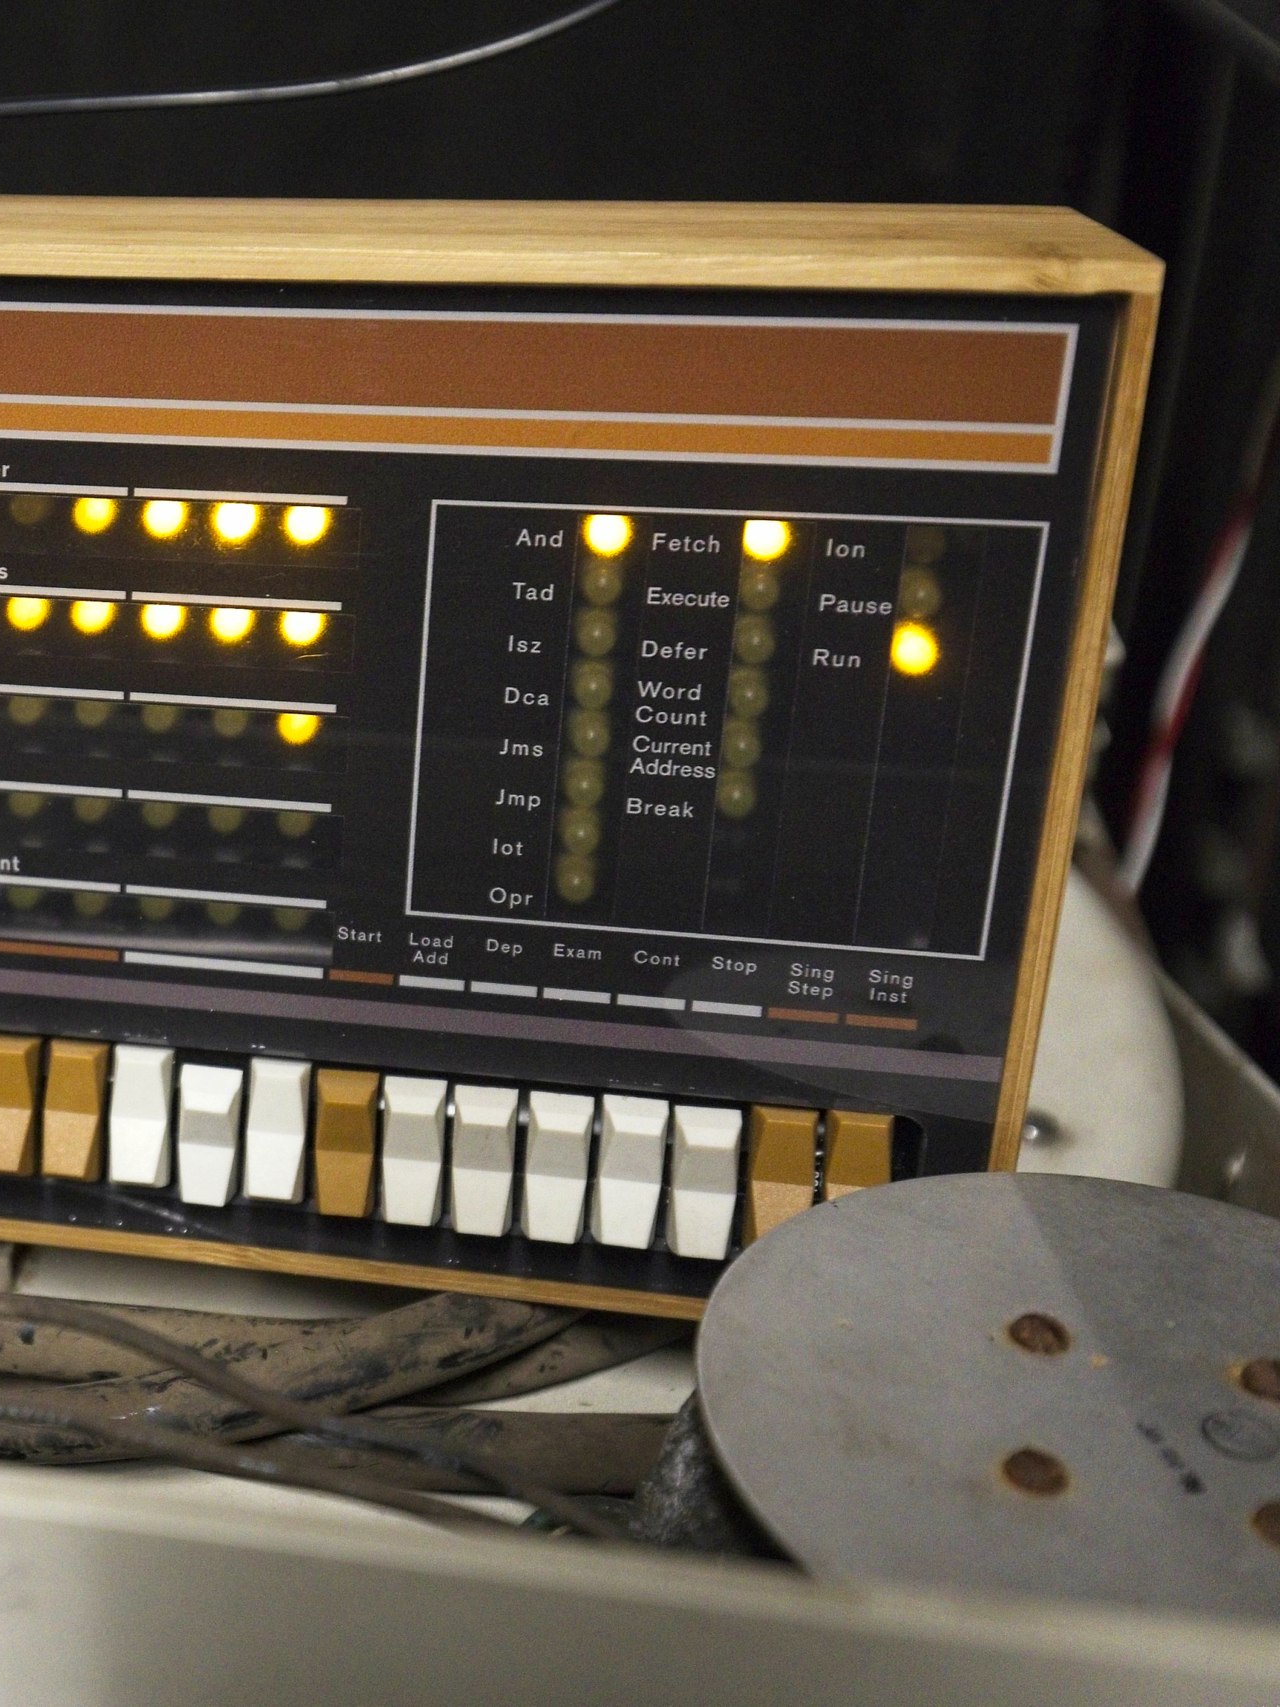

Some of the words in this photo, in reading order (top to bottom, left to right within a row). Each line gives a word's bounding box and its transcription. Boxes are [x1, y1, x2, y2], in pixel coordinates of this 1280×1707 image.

[516, 529, 563, 547] And
[652, 533, 720, 552] Fetch
[826, 539, 864, 557] Ion
[513, 582, 554, 600] Tad
[647, 587, 729, 607] Execute
[819, 594, 892, 615] Pause
[509, 635, 541, 653] Isz
[642, 640, 708, 659] Defer
[813, 649, 860, 667] Run
[505, 687, 549, 705] Dca
[638, 681, 701, 700] Word
[636, 706, 707, 726] Count
[500, 739, 543, 757] Jms
[633, 735, 712, 756] Current
[630, 758, 715, 778] Address
[496, 789, 540, 811] Jmp
[627, 798, 693, 817] Break
[493, 838, 523, 855] Iot
[490, 887, 533, 908] Opr
[338, 927, 381, 942] Start
[409, 933, 453, 948] Load
[487, 939, 522, 956] Dep
[554, 944, 601, 960] Exam
[413, 951, 448, 964] Add
[634, 951, 680, 966] Cont
[712, 957, 757, 975] Stop
[791, 963, 834, 982] Sing
[869, 970, 913, 989] Sing
[788, 981, 832, 999] Step
[870, 988, 907, 1003] Inst
